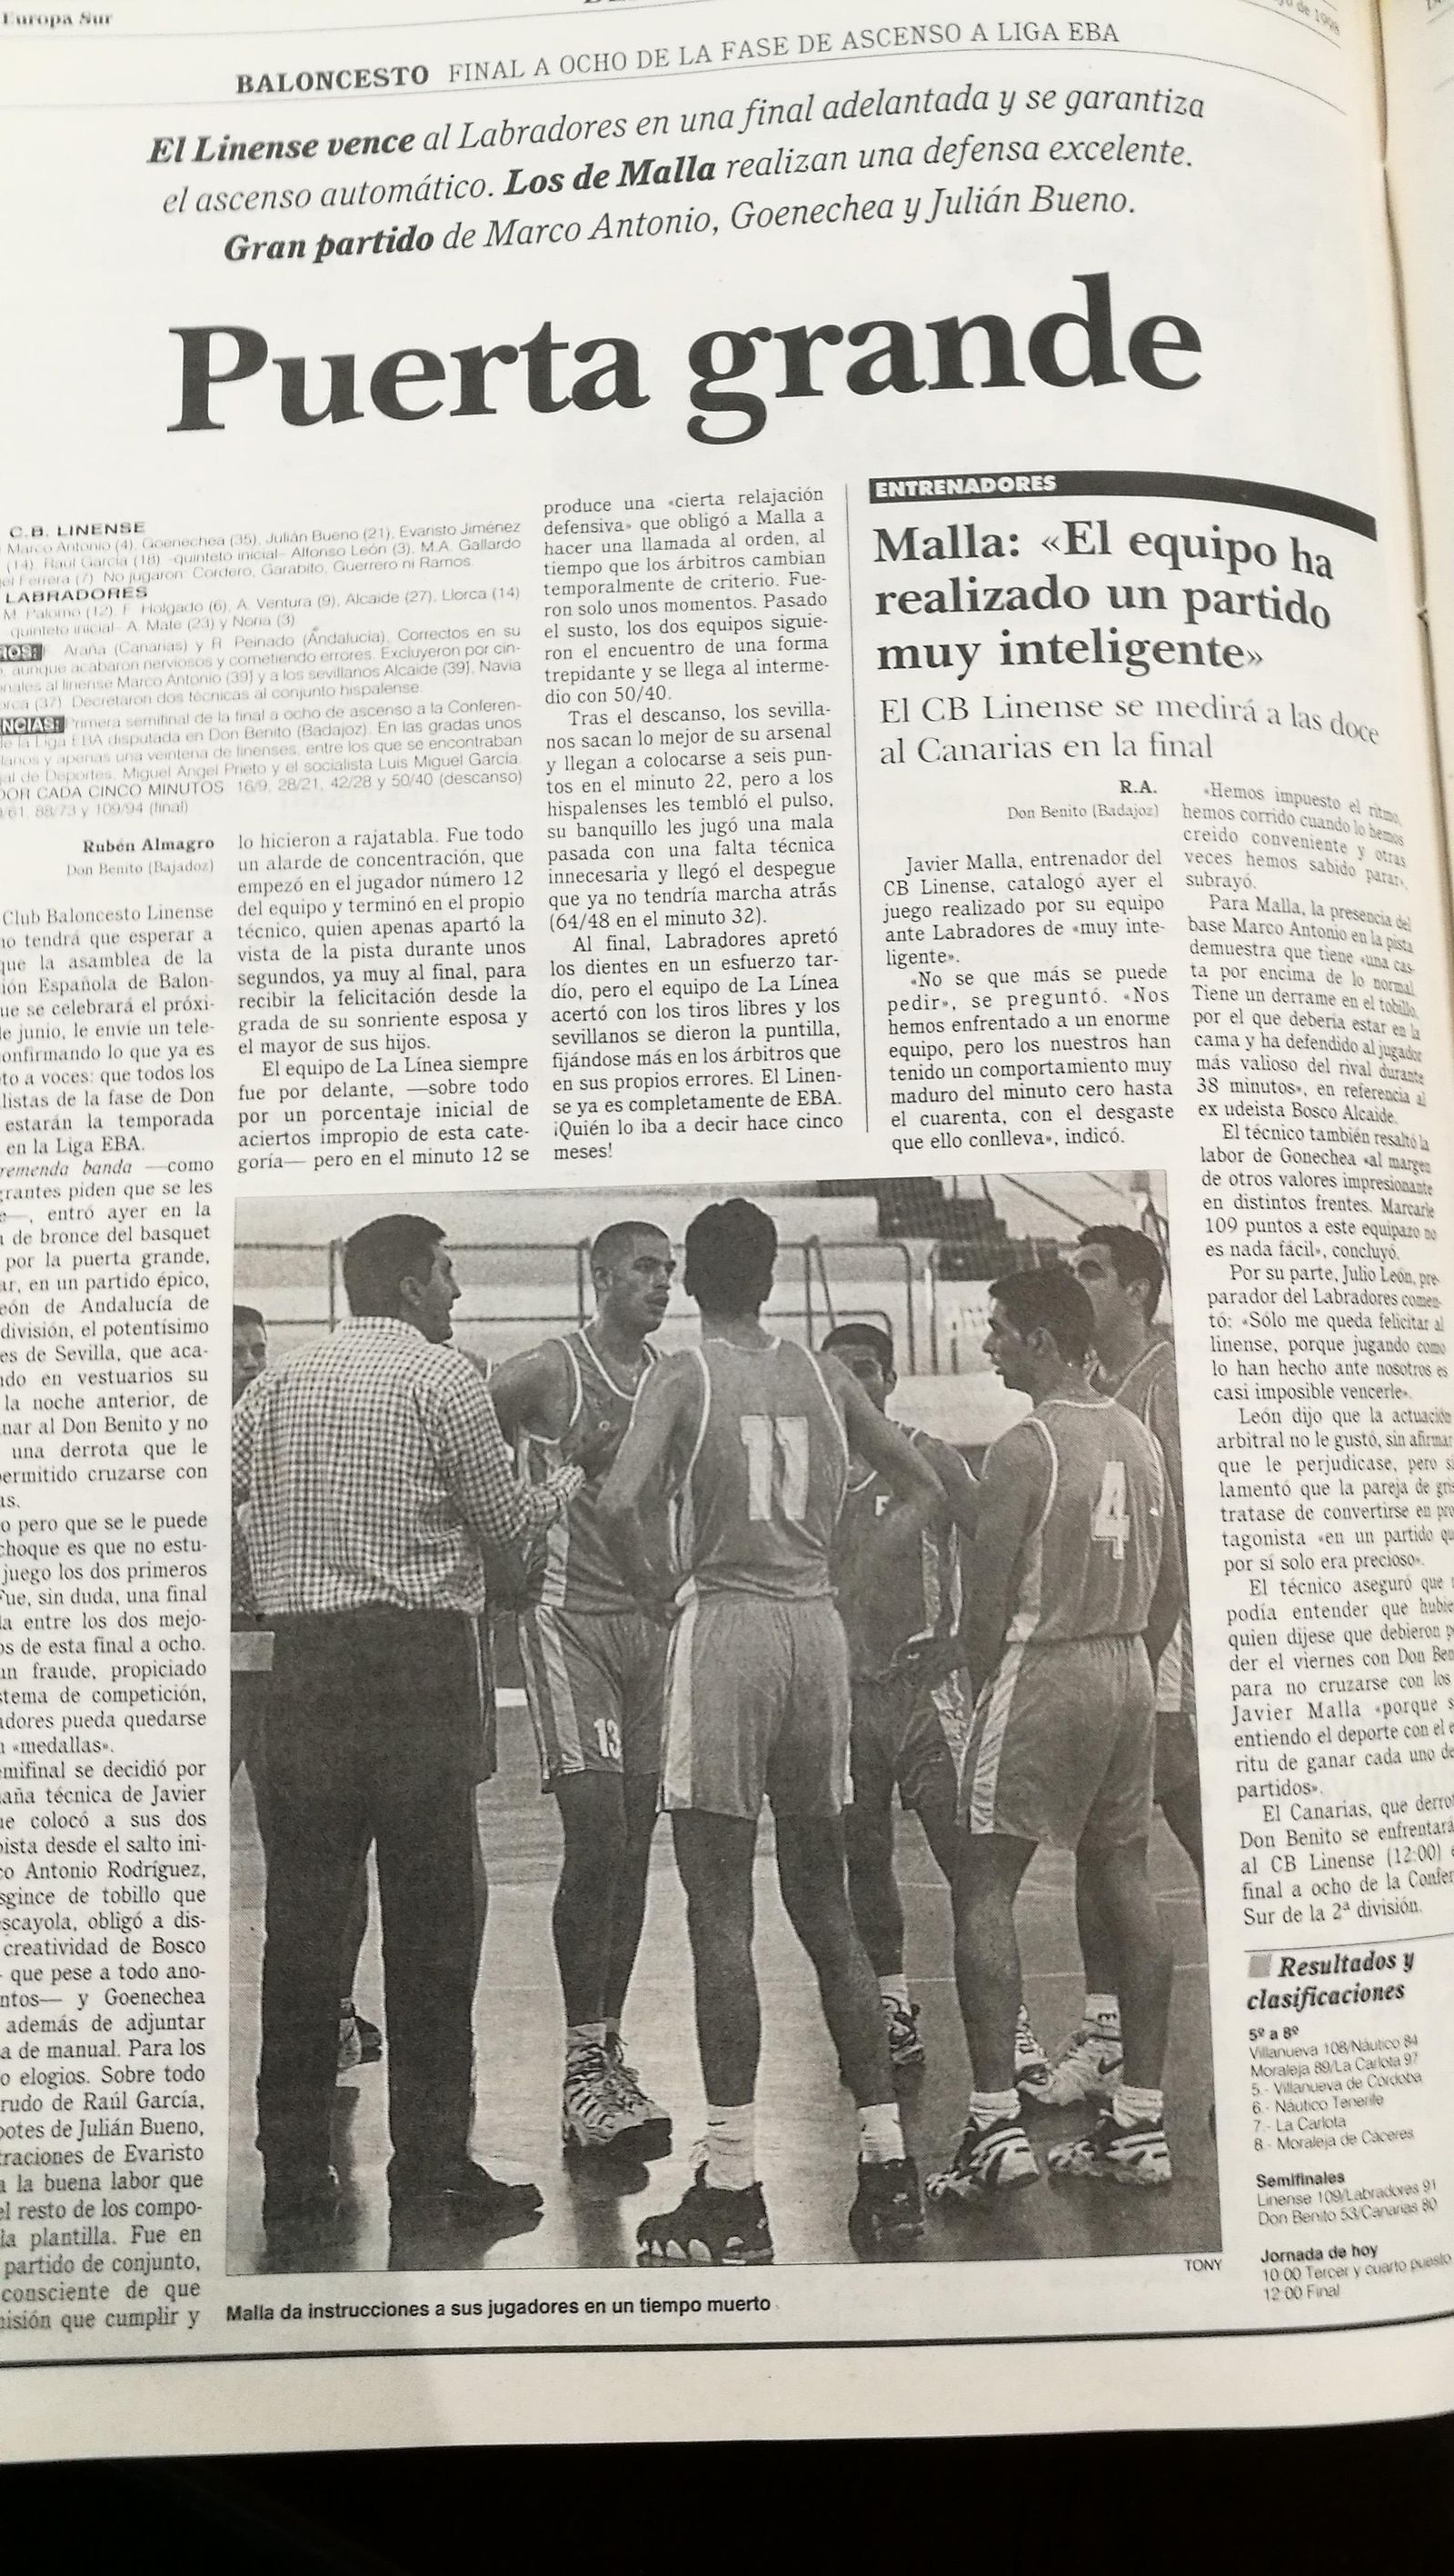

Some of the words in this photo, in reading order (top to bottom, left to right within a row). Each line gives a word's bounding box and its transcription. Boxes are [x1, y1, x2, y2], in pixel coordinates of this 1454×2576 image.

[235, 65, 429, 95] BALONCESTO
[449, 59, 525, 83] FINAL
[533, 57, 551, 76] A
[560, 52, 626, 75] OCHO
[637, 48, 670, 69] DE
[679, 45, 712, 65] LA
[722, 36, 789, 61] FASE
[798, 34, 832, 54] DE
[842, 23, 961, 50] ASCENSO
[971, 23, 989, 42] A
[998, 22, 1060, 41] LIGA
[1068, 22, 1120, 42] EBA
[146, 135, 186, 165] El
[191, 134, 319, 163] Linense
[327, 133, 415, 156] vence
[423, 123, 452, 151] al
[456, 114, 627, 149] Labradores
[636, 115, 669, 136] en
[681, 109, 734, 133] una
[737, 94, 814, 135] final
[822, 83, 989, 120] adelantada
[999, 90, 1016, 116] y
[1025, 90, 1057, 109] se
[1064, 88, 1204, 118] garantiza
[163, 185, 189, 215] el
[196, 189, 312, 213] ascenso
[321, 173, 495, 206] automático.
[503, 168, 565, 195] Los
[573, 162, 611, 190] de
[615, 155, 716, 187] Malla
[727, 147, 847, 179] realizan
[859, 146, 914, 168] una
[923, 134, 1040, 170] defensa
[1049, 133, 1192, 167] excelente.
[224, 234, 305, 262] Gran
[312, 224, 434, 264] partido
[443, 221, 476, 249] de
[483, 219, 581, 247] Marco
[587, 206, 719, 240] Antonio,
[732, 193, 894, 229] Goenechea
[902, 197, 921, 224] y
[924, 185, 1020, 224] Julián
[1028, 185, 1135, 214] Bueno.
[167, 320, 650, 433] Puerta
[686, 272, 1202, 444] grande
[875, 475, 1057, 497] ENTRENADORES
[543, 498, 612, 518] produce
[624, 498, 656, 511] una
[669, 493, 725, 508] «cierta
[738, 486, 824, 506] relajación
[56, 521, 145, 536] LINENSE
[872, 523, 1020, 562] Malla:
[1041, 519, 1112, 555] «El
[1129, 524, 1278, 575] equipo
[1290, 535, 1335, 581] ha
[5, 586, 148, 604] LABRADORES
[875, 573, 1090, 615] realizado
[1106, 585, 1168, 610] un
[1181, 584, 1330, 629] partido
[876, 643, 981, 681] muy
[999, 626, 1263, 677] inteligente»
[545, 688, 571, 704] dio
[578, 692, 607, 704] con
[614, 685, 672, 703] 50/40.
[880, 697, 911, 724] El
[921, 696, 969, 722] CB
[982, 694, 1103, 719] Linense
[1115, 700, 1144, 716] se
[1156, 694, 1258, 723] medirá
[1267, 708, 1281, 725] a
[1290, 702, 1322, 731] las
[1330, 711, 1379, 744] doce
[881, 737, 906, 764] al
[918, 734, 1051, 763] Canarias
[1063, 740, 1100, 757] en
[1112, 731, 1138, 756] la
[1149, 731, 1212, 758] final
[1119, 780, 1157, 794] R.A.
[1008, 807, 1035, 819] Don
[1041, 804, 1087, 818] Benito
[1092, 804, 1158, 820] (Badajoz)
[84, 839, 135, 854] Rubén
[141, 837, 214, 854] Almagro
[905, 855, 959, 876] Javier
[965, 853, 1022, 870] Malla,
[1031, 849, 1129, 867] entrenador
[1136, 849, 1161, 864] del
[3, 909, 40, 925] Club
[47, 907, 140, 924] Baloncesto
[147, 904, 213, 921] Linense
[262, 1060, 280, 1076] El
[285, 1059, 344, 1080] equipo
[350, 1058, 370, 1073] de
[375, 1057, 399, 1073] La
[403, 1056, 453, 1073] Línea
[458, 1054, 528, 1074] siempre
[554, 1120, 610, 1141] ¡Quién
[618, 1119, 633, 1134] lo
[642, 1118, 668, 1134] iba
[676, 1122, 687, 1133] a
[693, 1115, 739, 1133] decir
[747, 1114, 788, 1131] hace
[796, 1113, 843, 1129] cinco
[553, 1142, 612, 1160] meses!
[6, 1256, 35, 1273] por
[45, 1252, 61, 1268] la
[73, 1251, 131, 1271] puerta
[141, 1246, 209, 1269] grande,
[1214, 1383, 1250, 1401] casi
[1255, 1382, 1334, 1403] imposible
[740, 1414, 809, 1520] 11
[1090, 1461, 1130, 1559] 4
[593, 1718, 622, 1759] 13
[1243, 1907, 1275, 1926] Sur
[1282, 1905, 1303, 1924] de
[1310, 1903, 1325, 1922] la
[1332, 1902, 1350, 1920] 2ª
[1357, 1896, 1422, 1918] división.
[2, 1932, 108, 1958] creatividad
[119, 1936, 142, 1955] de
[151, 1936, 205, 1955] Bosco
[1277, 1949, 1398, 1978] Resultados
[1403, 1952, 1415, 1973] y
[1246, 1982, 1406, 2014] clasificaciones
[1256, 2171, 1346, 2188] Semifinales
[1183, 2258, 1222, 2273] TONY
[1260, 2247, 1324, 2265] Jornada
[1328, 2245, 1348, 2261] de
[1351, 2243, 1378, 2263] hoy
[225, 2303, 274, 2322] Malla
[279, 2303, 304, 2321] da
[307, 2301, 430, 2320] instrucciones
[434, 2304, 445, 2317] a
[451, 2302, 483, 2316] sus
[487, 2298, 580, 2320] jugadores
[583, 2299, 607, 2315] en
[612, 2299, 634, 2315] un
[639, 2296, 703, 2317] tiempo
[706, 2295, 771, 2312] muerto
